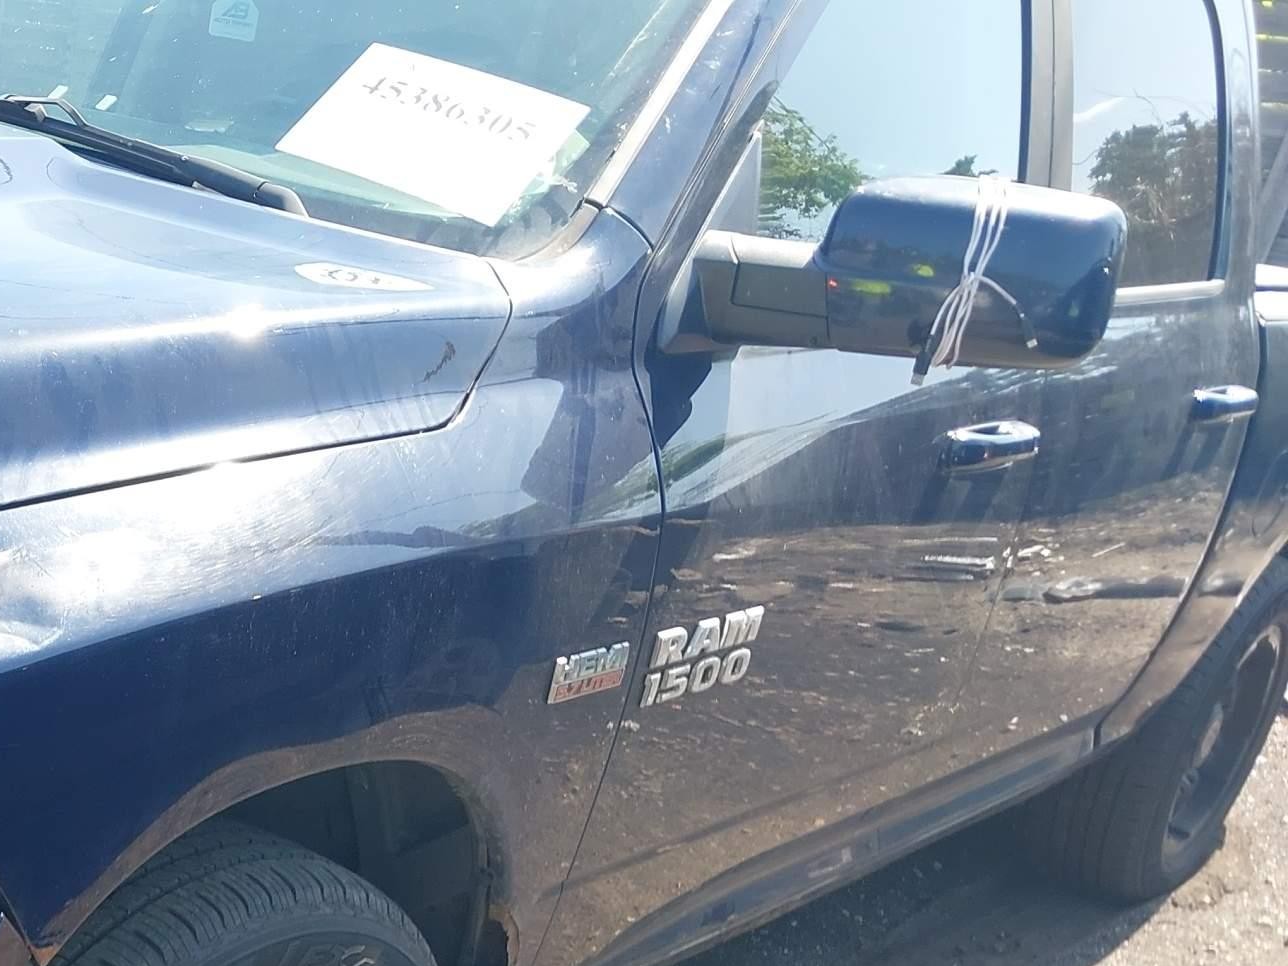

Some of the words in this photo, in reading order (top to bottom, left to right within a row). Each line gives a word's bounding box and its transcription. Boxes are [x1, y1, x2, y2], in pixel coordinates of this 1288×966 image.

[361, 76, 537, 141] 45386305
[650, 605, 765, 668] RAM
[639, 647, 752, 708] 1500
